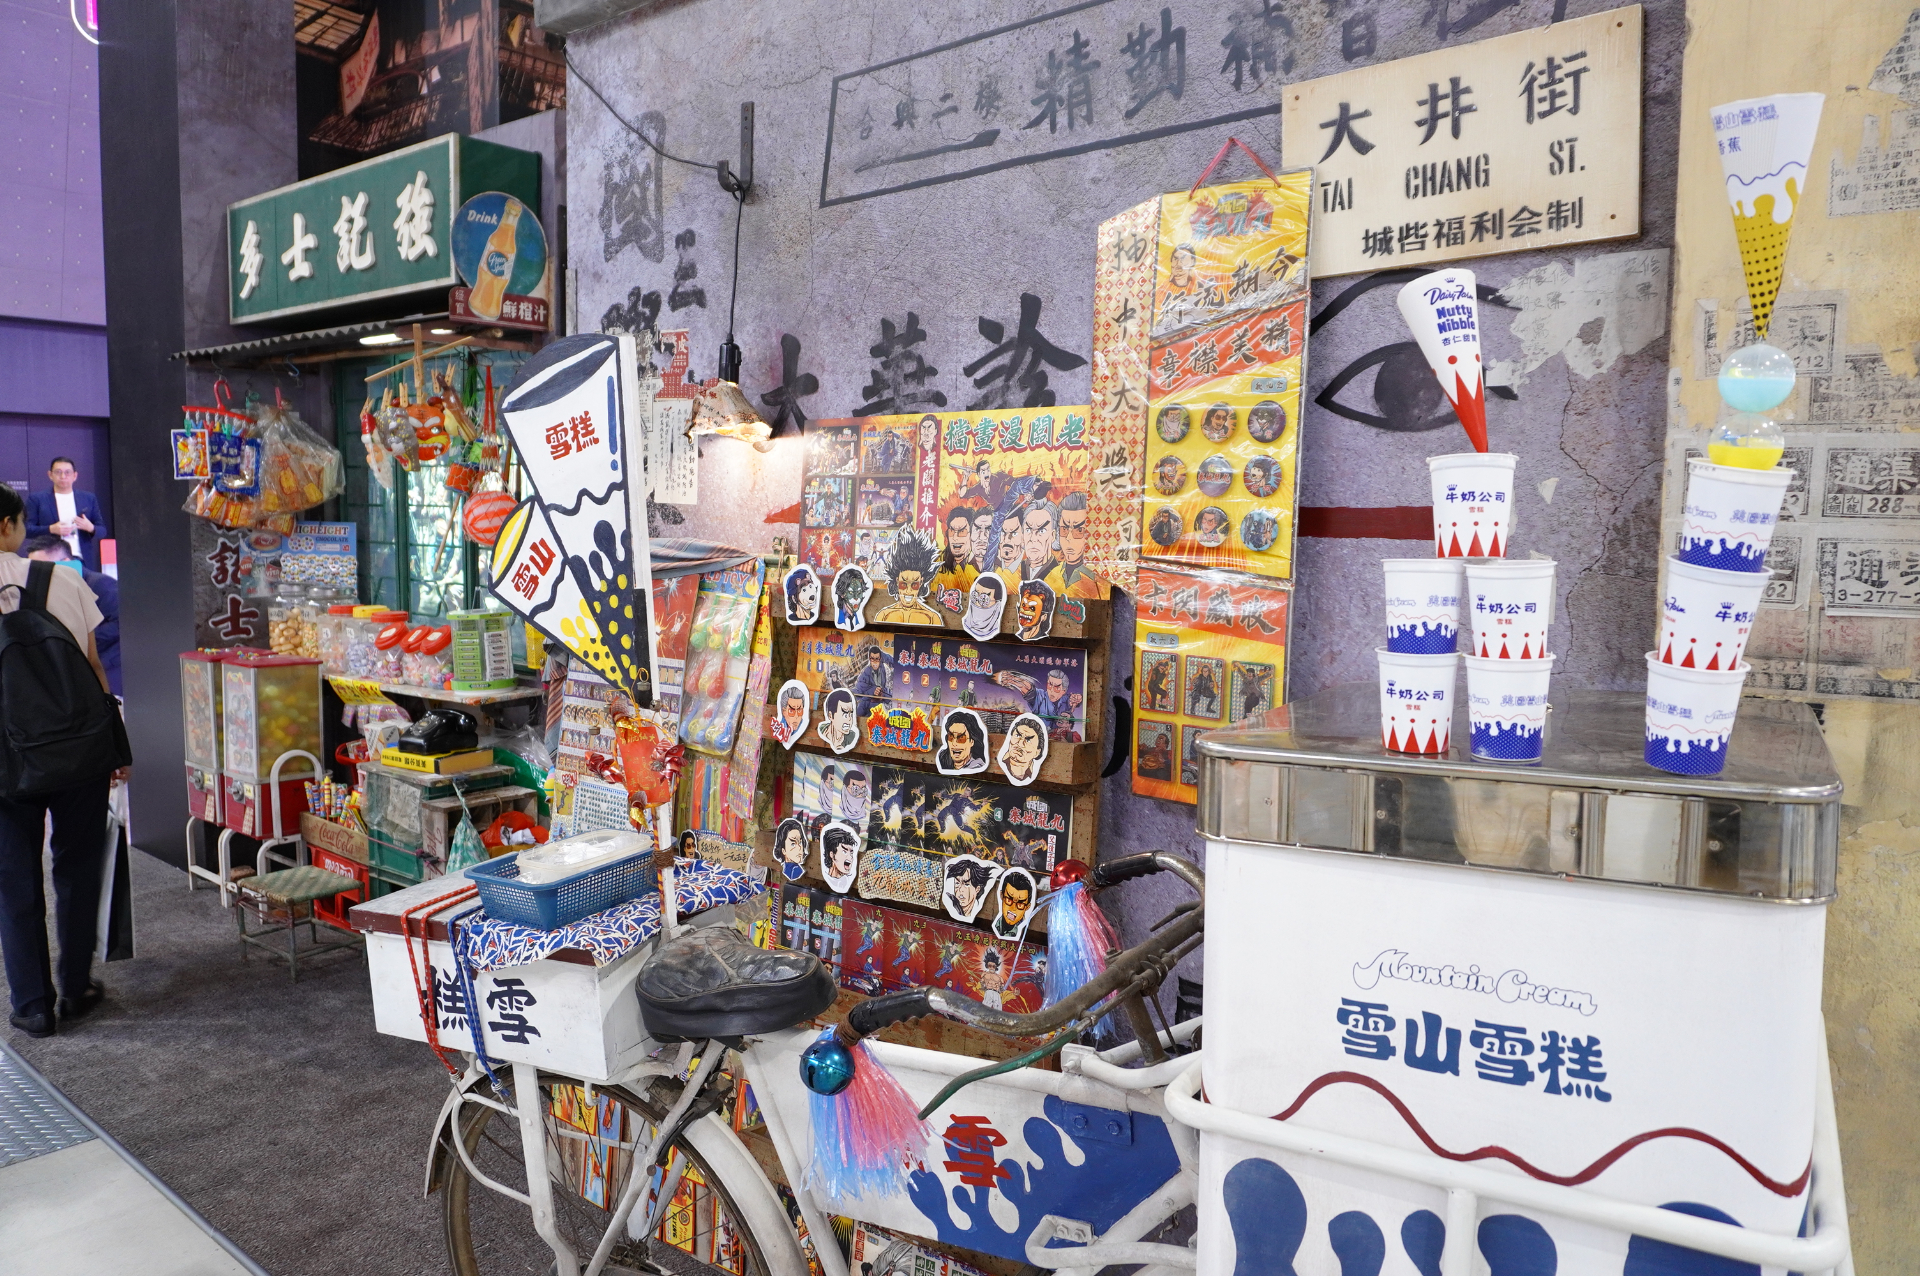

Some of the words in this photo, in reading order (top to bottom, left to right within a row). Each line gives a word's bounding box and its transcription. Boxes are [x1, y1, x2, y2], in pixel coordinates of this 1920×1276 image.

[1321, 178, 1354, 214] TAI
[1405, 154, 1491, 201] CHANG
[1549, 137, 1586, 176] ST.
[467, 209, 498, 225] Drink
[1423, 287, 1456, 305] Dairy
[502, 300, 547, 322] 鮮橙汁
[1436, 304, 1473, 320] Nutty
[1437, 316, 1475, 334] Nibble
[545, 410, 600, 461] 雪糕
[1445, 491, 1506, 504] 牛奶公司
[510, 537, 556, 601] 雪山
[723, 572, 749, 585] TOY
[1476, 602, 1537, 615] 牛奶公司
[944, 655, 993, 675] 九龍城寨
[903, 671, 911, 684] 2
[921, 673, 929, 687] 2
[950, 677, 957, 690] 2
[1386, 687, 1445, 701] 牛奶公司
[1405, 703, 1422, 711] 雪糕
[871, 725, 929, 750] 九龍城寨
[994, 808, 1003, 821] 4
[1008, 806, 1065, 832] 九龍城寨
[786, 929, 793, 941] 5
[814, 938, 822, 949] 5
[1352, 948, 1497, 995] Mountain
[1495, 969, 1598, 1018] Cream
[1336, 996, 1613, 1102] 雪山雪糕
